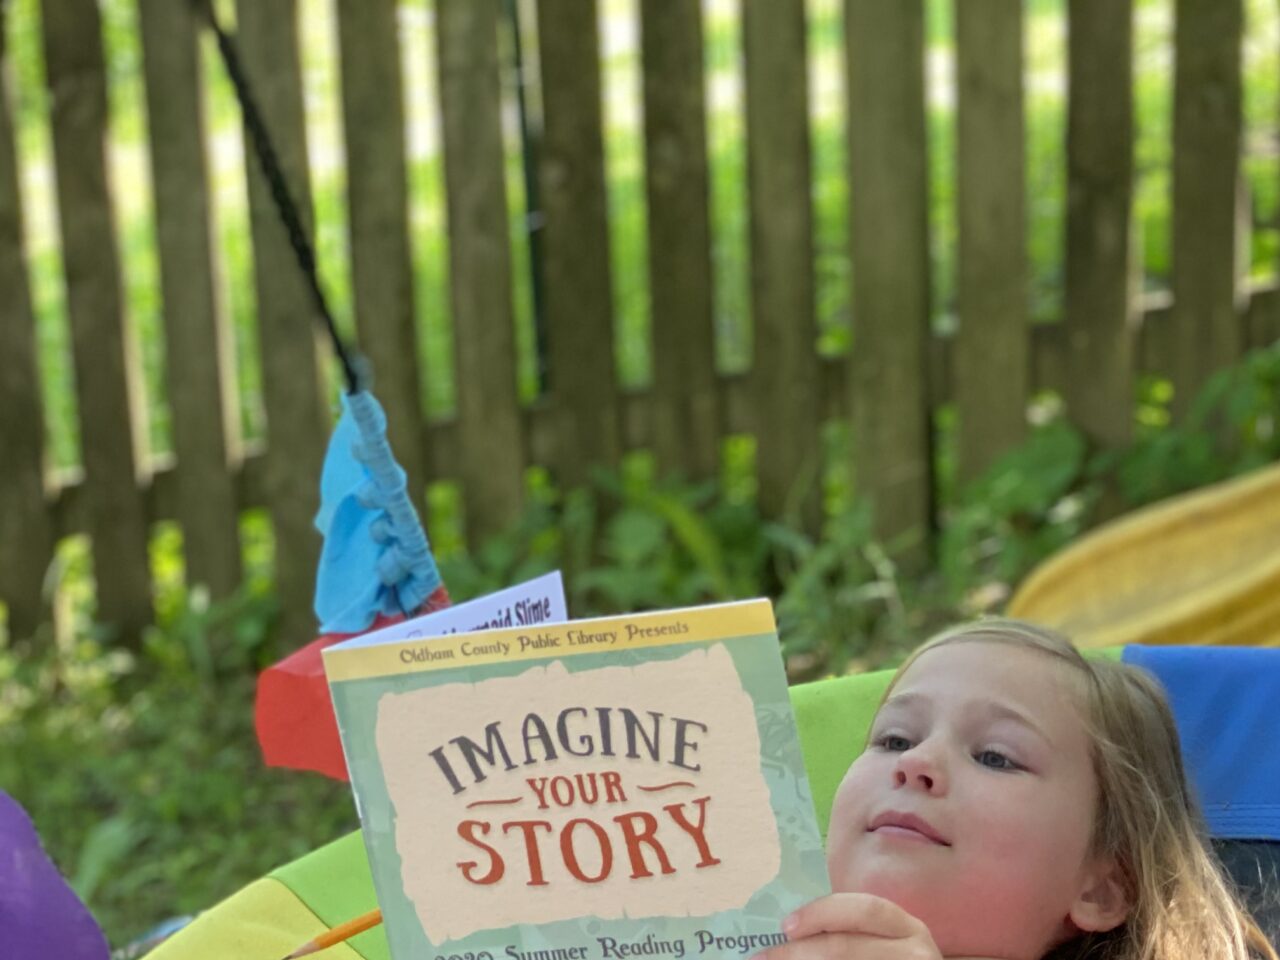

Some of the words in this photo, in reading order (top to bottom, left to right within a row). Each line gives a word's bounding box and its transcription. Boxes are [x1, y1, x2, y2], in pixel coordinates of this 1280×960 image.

[514, 597, 551, 627] Slime
[399, 647, 454, 664] Oldham
[461, 640, 510, 656] County
[517, 633, 561, 652] Public
[567, 629, 618, 645] Library
[624, 621, 689, 641] Presents
[428, 706, 708, 795] IMAGINE
[525, 771, 628, 809] YOUR
[456, 796, 721, 886] STORY
[596, 932, 686, 960] Reading
[694, 930, 788, 954] Program
